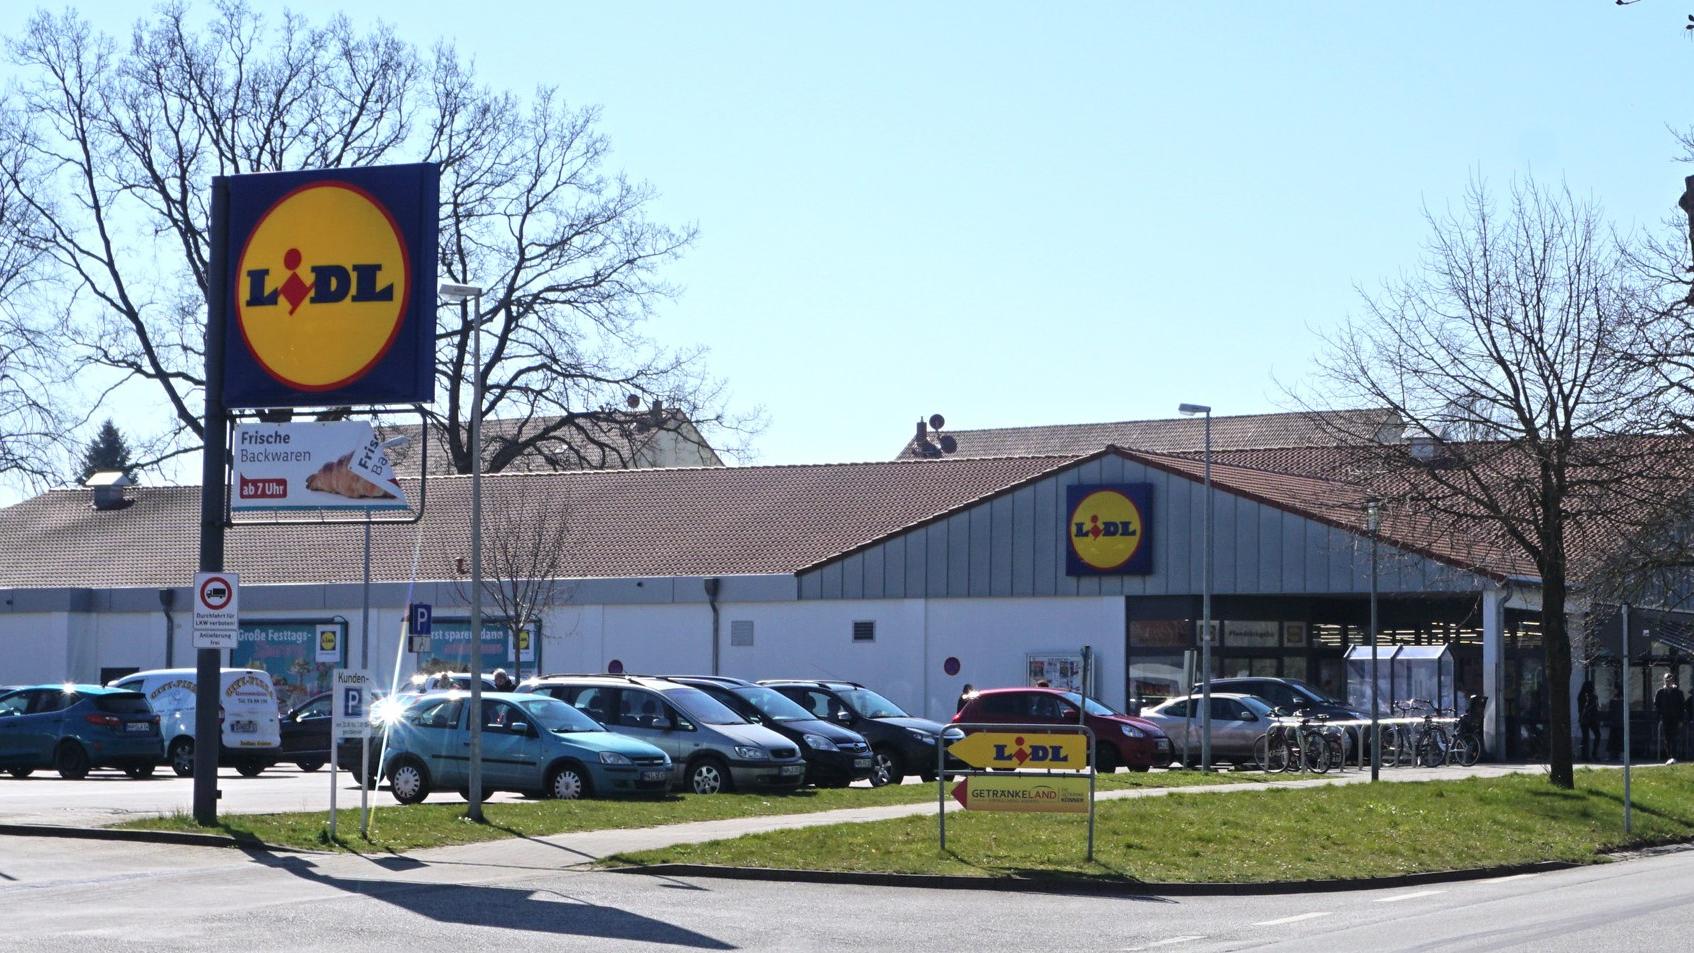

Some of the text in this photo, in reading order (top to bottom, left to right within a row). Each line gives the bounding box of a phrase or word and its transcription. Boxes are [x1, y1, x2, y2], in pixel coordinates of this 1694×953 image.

[241, 431, 290, 444] Frische
[241, 449, 311, 463] Backwaren
[243, 483, 285, 496] ab 7 Uhr
[417, 608, 428, 632] P
[238, 629, 311, 643] Große Festtags-
[431, 629, 443, 640] rst
[338, 673, 369, 684] Kunden-
[348, 690, 360, 714] P
[971, 786, 1057, 799] GETRÄNKELAND
